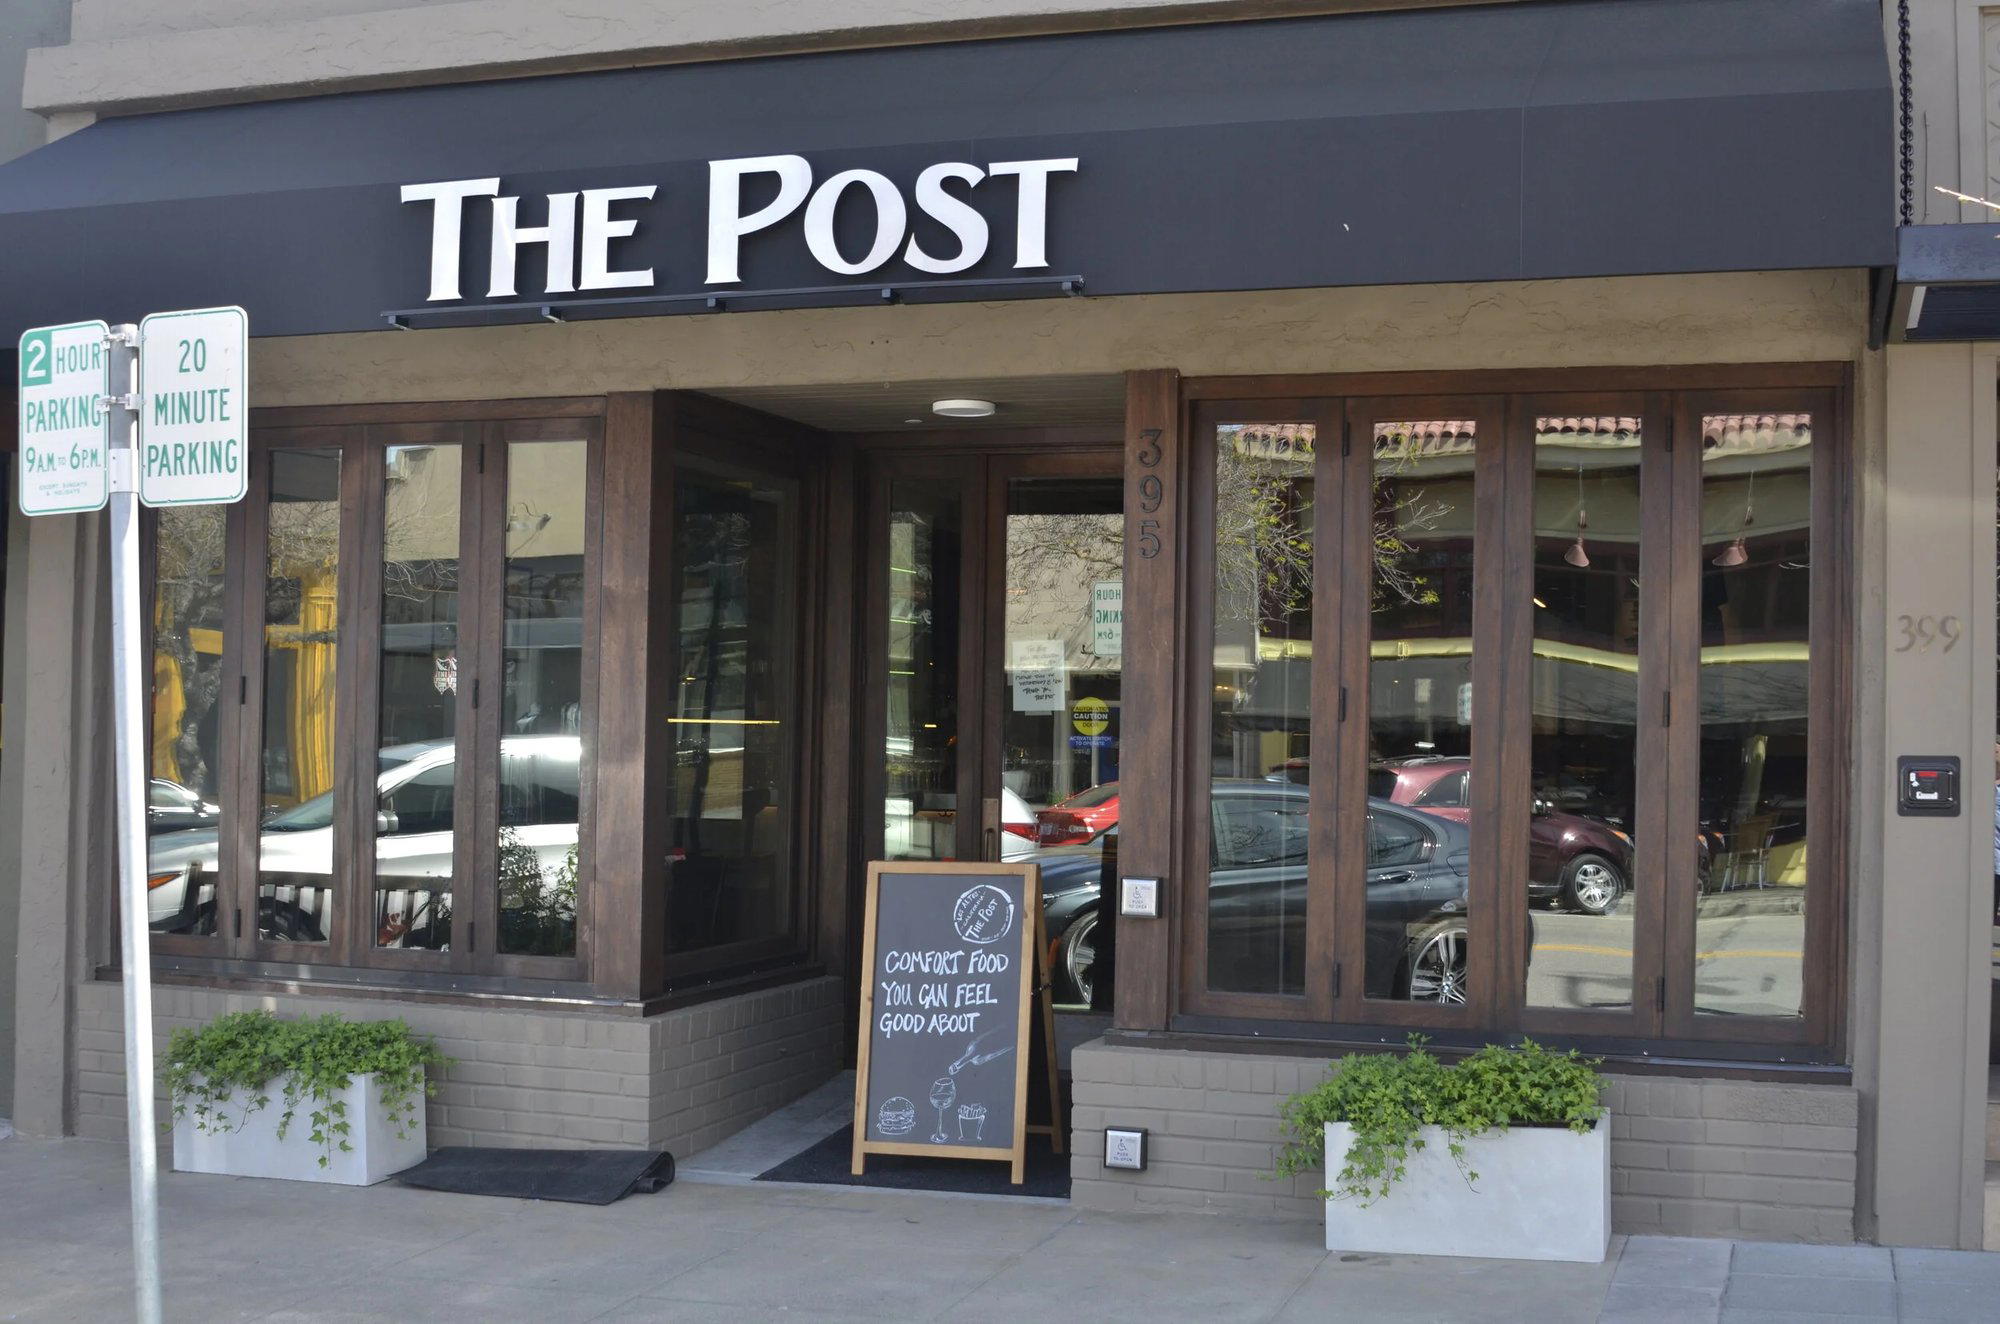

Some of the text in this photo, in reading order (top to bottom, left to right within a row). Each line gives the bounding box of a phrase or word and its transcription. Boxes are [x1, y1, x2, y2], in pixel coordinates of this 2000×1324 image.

[401, 154, 1079, 301] THE POST
[27, 339, 101, 379] 2 HOUR
[178, 338, 207, 373] 20
[27, 393, 102, 434] PARKING
[154, 388, 231, 427] MINUTE
[147, 438, 238, 478] PARKING
[1137, 428, 1163, 560] 395
[1893, 614, 1961, 656] 399
[965, 919, 986, 939] THE
[978, 898, 998, 922] POST
[885, 948, 1009, 976] COMFORT FOOD
[881, 981, 998, 1009] YOU CAN FEEL
[880, 1012, 981, 1039] GOOD ABOUT
